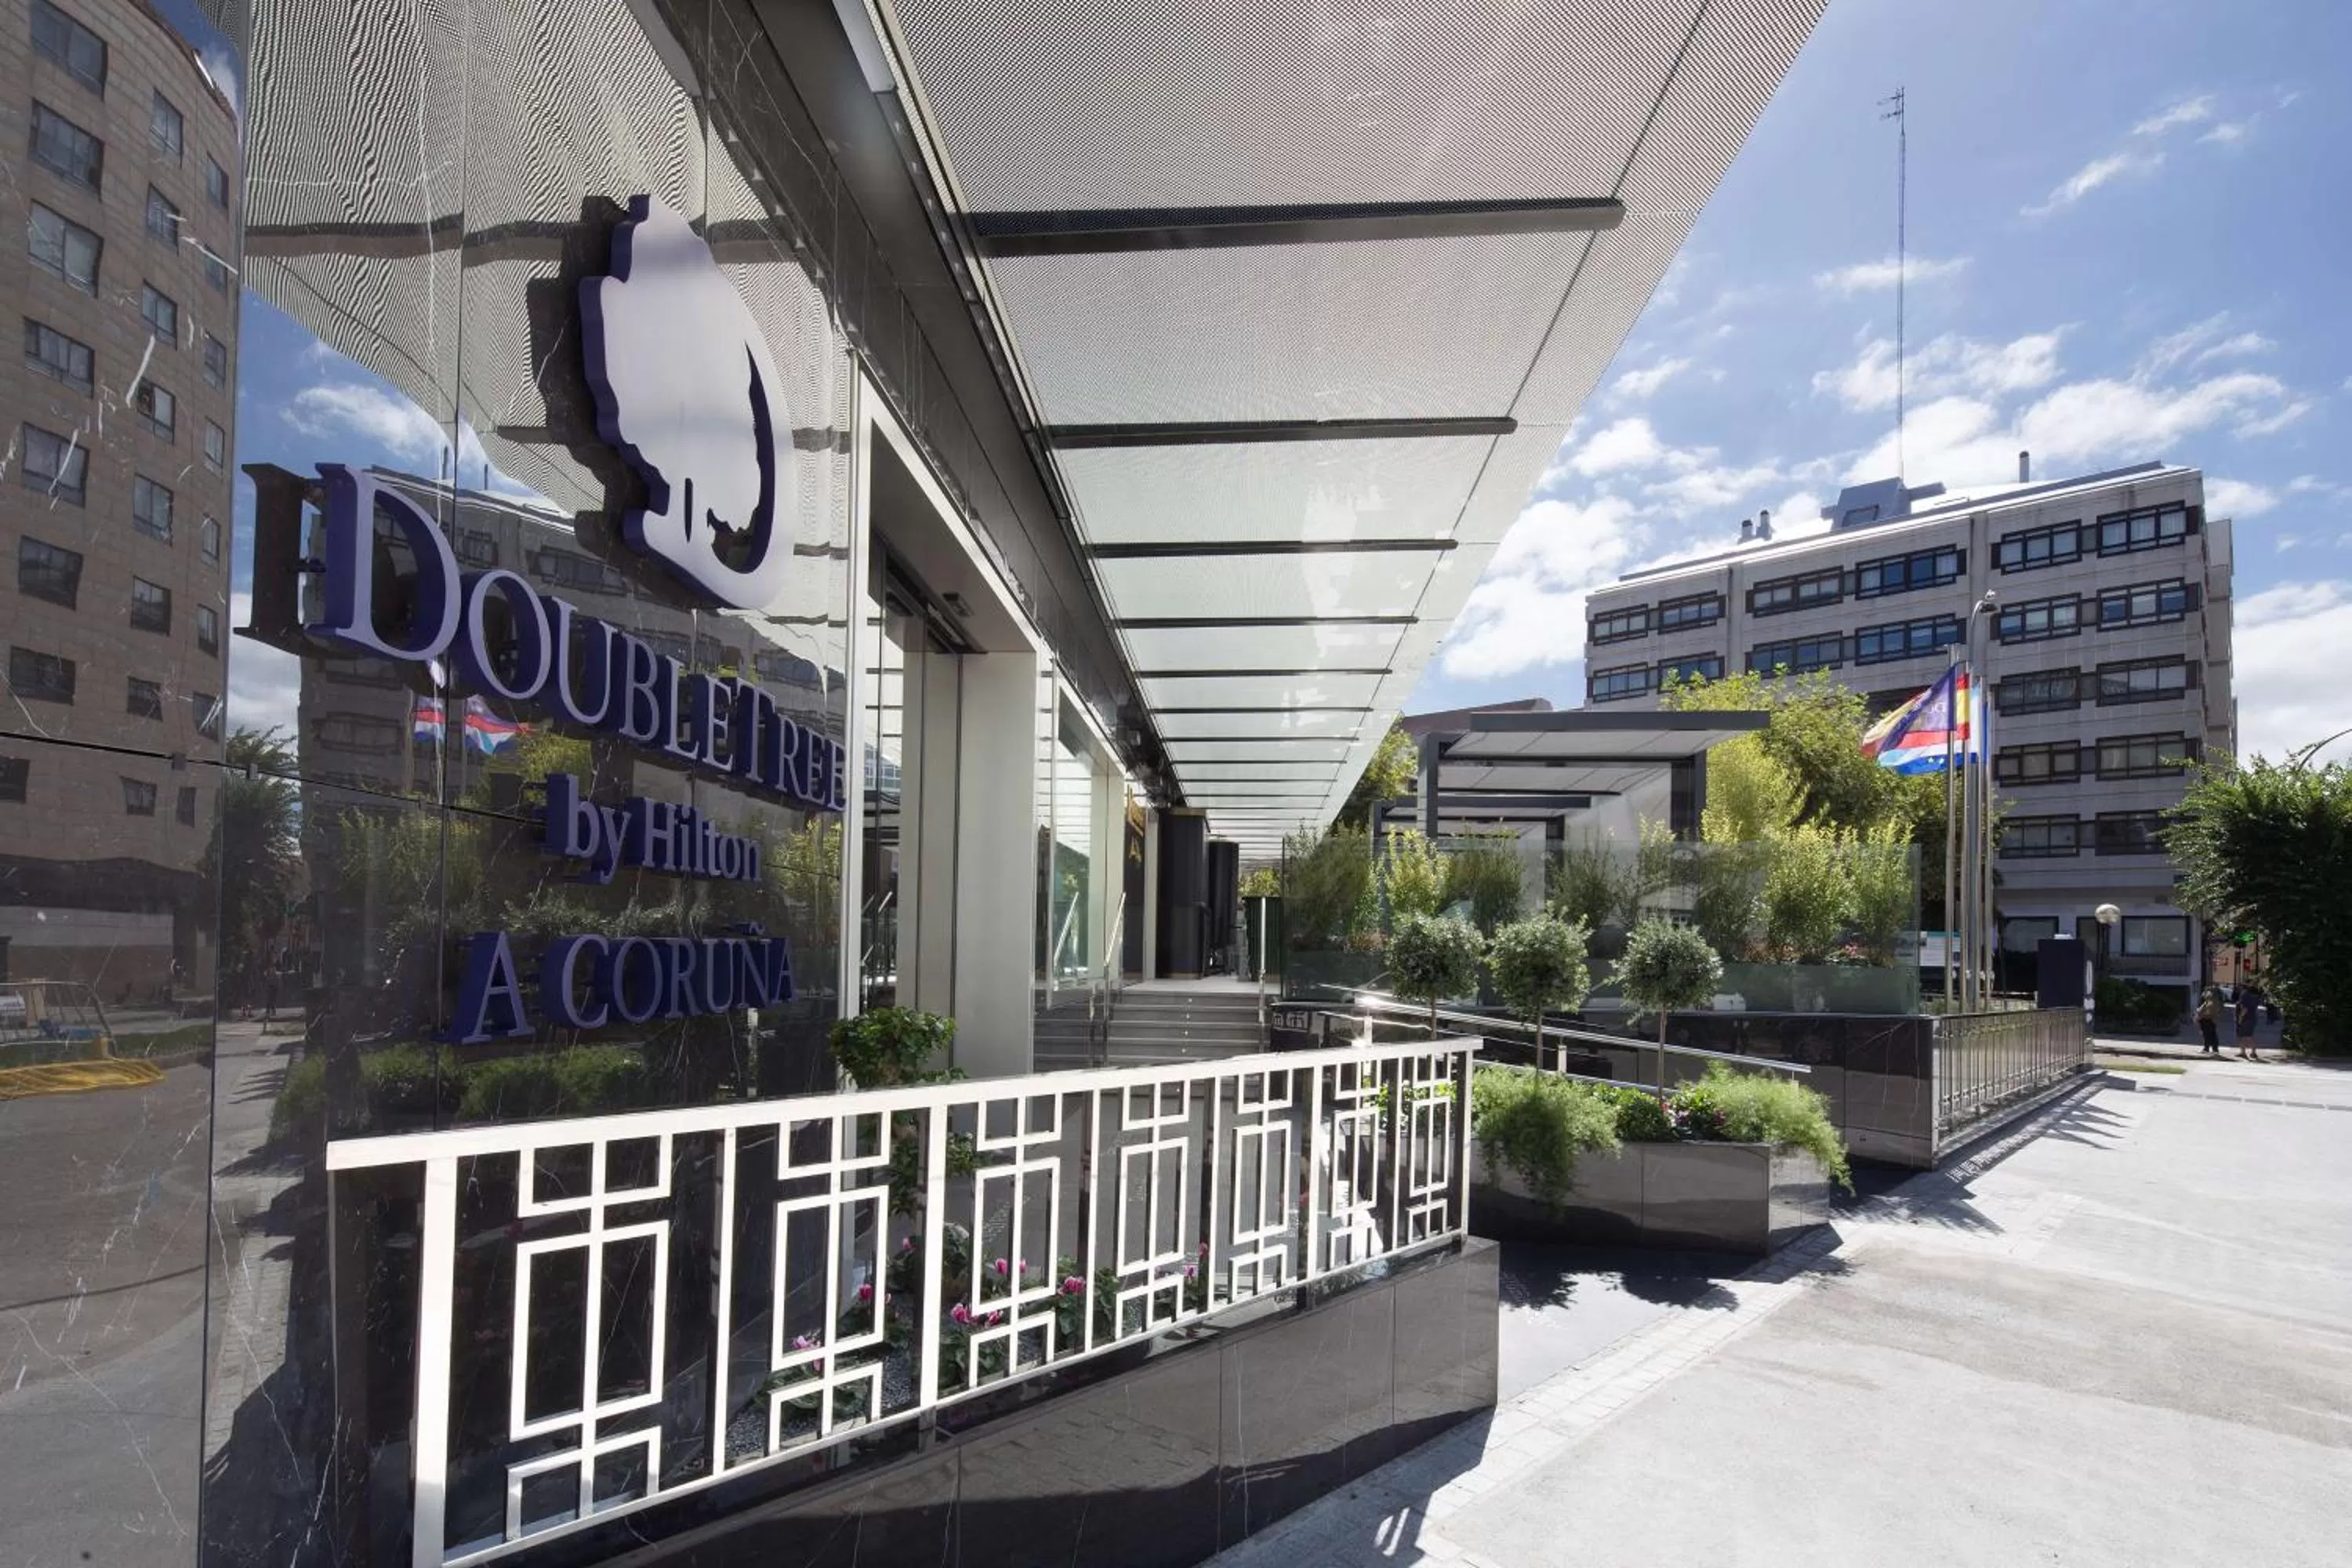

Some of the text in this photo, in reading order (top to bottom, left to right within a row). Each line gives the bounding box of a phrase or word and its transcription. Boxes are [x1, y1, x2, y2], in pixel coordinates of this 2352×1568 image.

[329, 463, 847, 812] DOUBLETREE
[562, 774, 763, 884] by Hilton
[461, 922, 797, 1044] A CORUÑA
